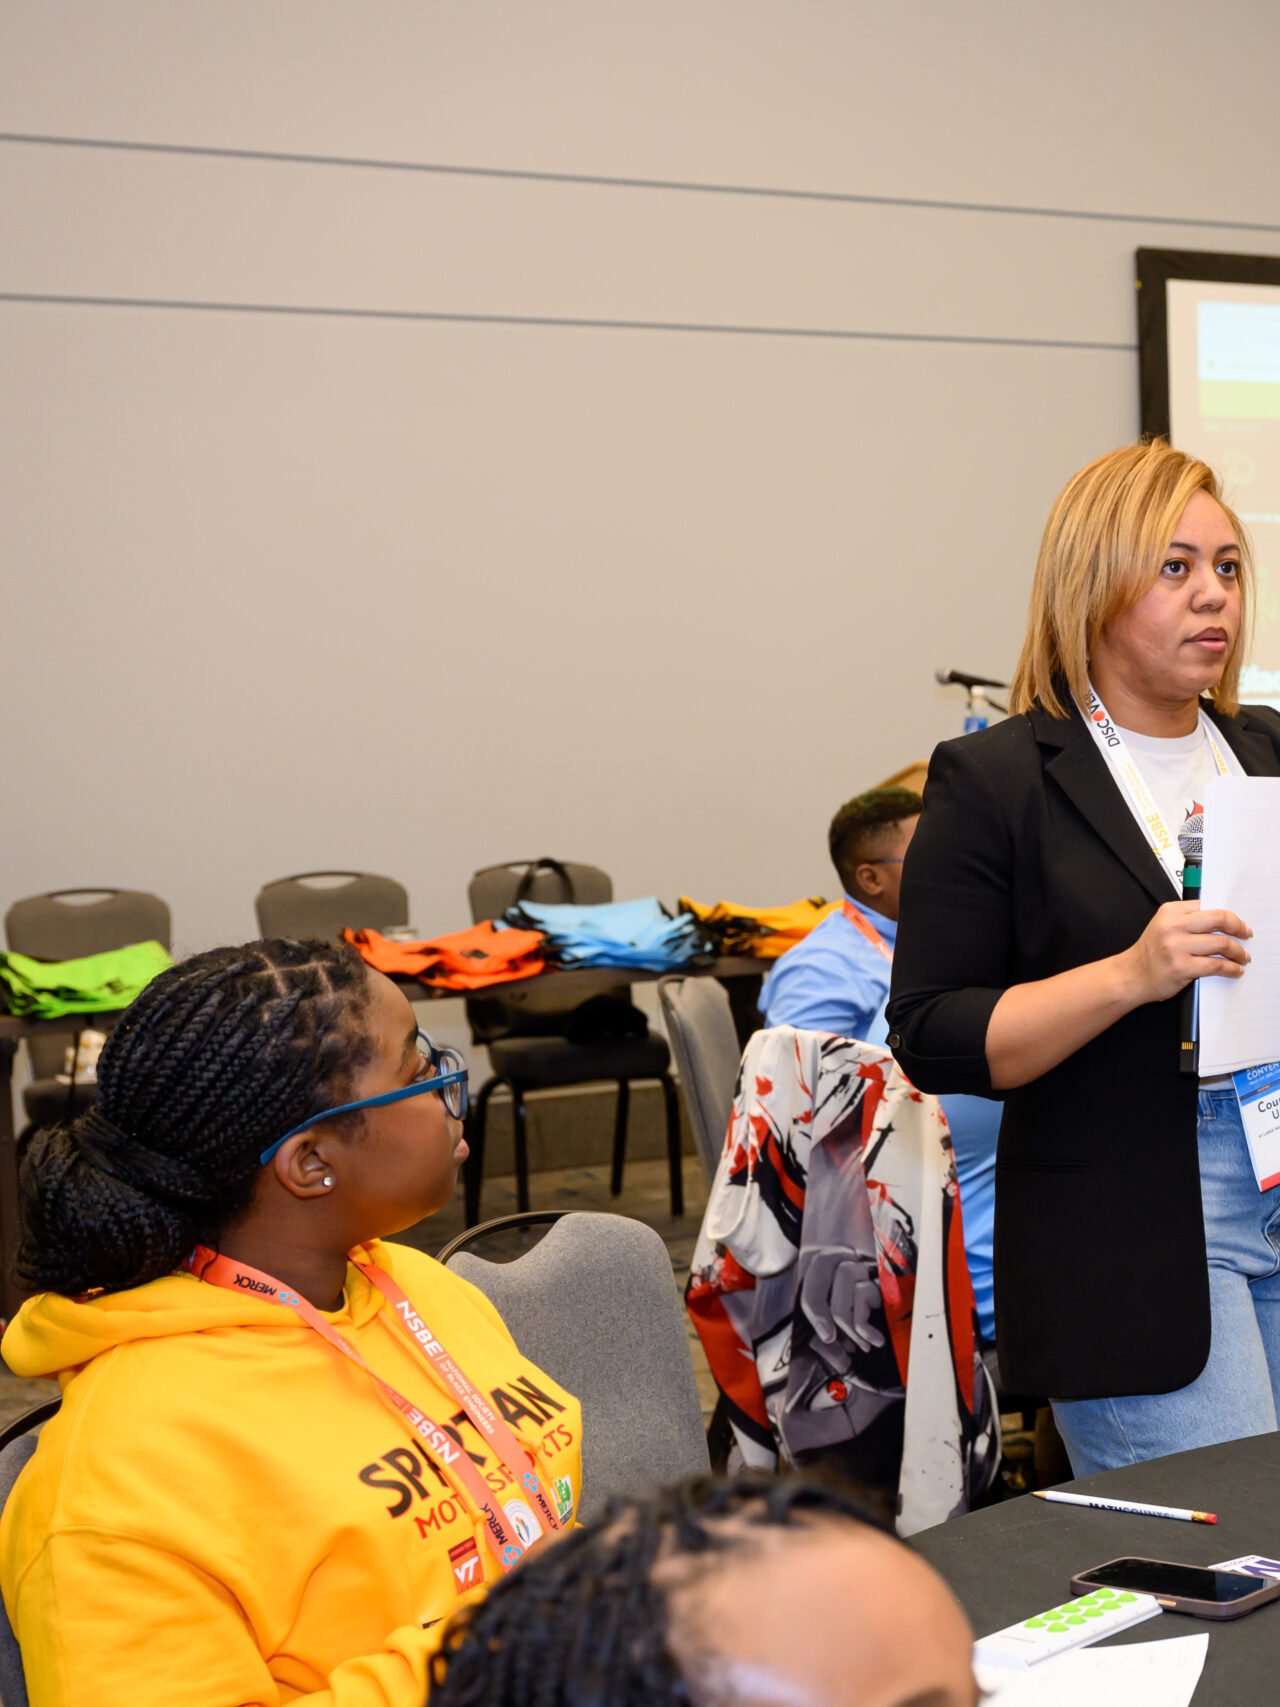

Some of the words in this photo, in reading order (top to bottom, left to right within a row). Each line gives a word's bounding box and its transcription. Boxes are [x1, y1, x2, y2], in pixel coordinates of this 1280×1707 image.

[1146, 811, 1174, 849] NSBE
[233, 1273, 278, 1296] MERCK
[396, 1300, 434, 1357] NSBE
[439, 1362, 449, 1373] OF
[447, 1373, 466, 1396] BLACK
[463, 1395, 496, 1435] ENGINEERS
[445, 1359, 473, 1394] NATIONAL
[470, 1393, 496, 1421] SOCIETY
[406, 1408, 460, 1464] NSBE
[480, 1502, 508, 1545] MERCK
[454, 1555, 480, 1583] VT
